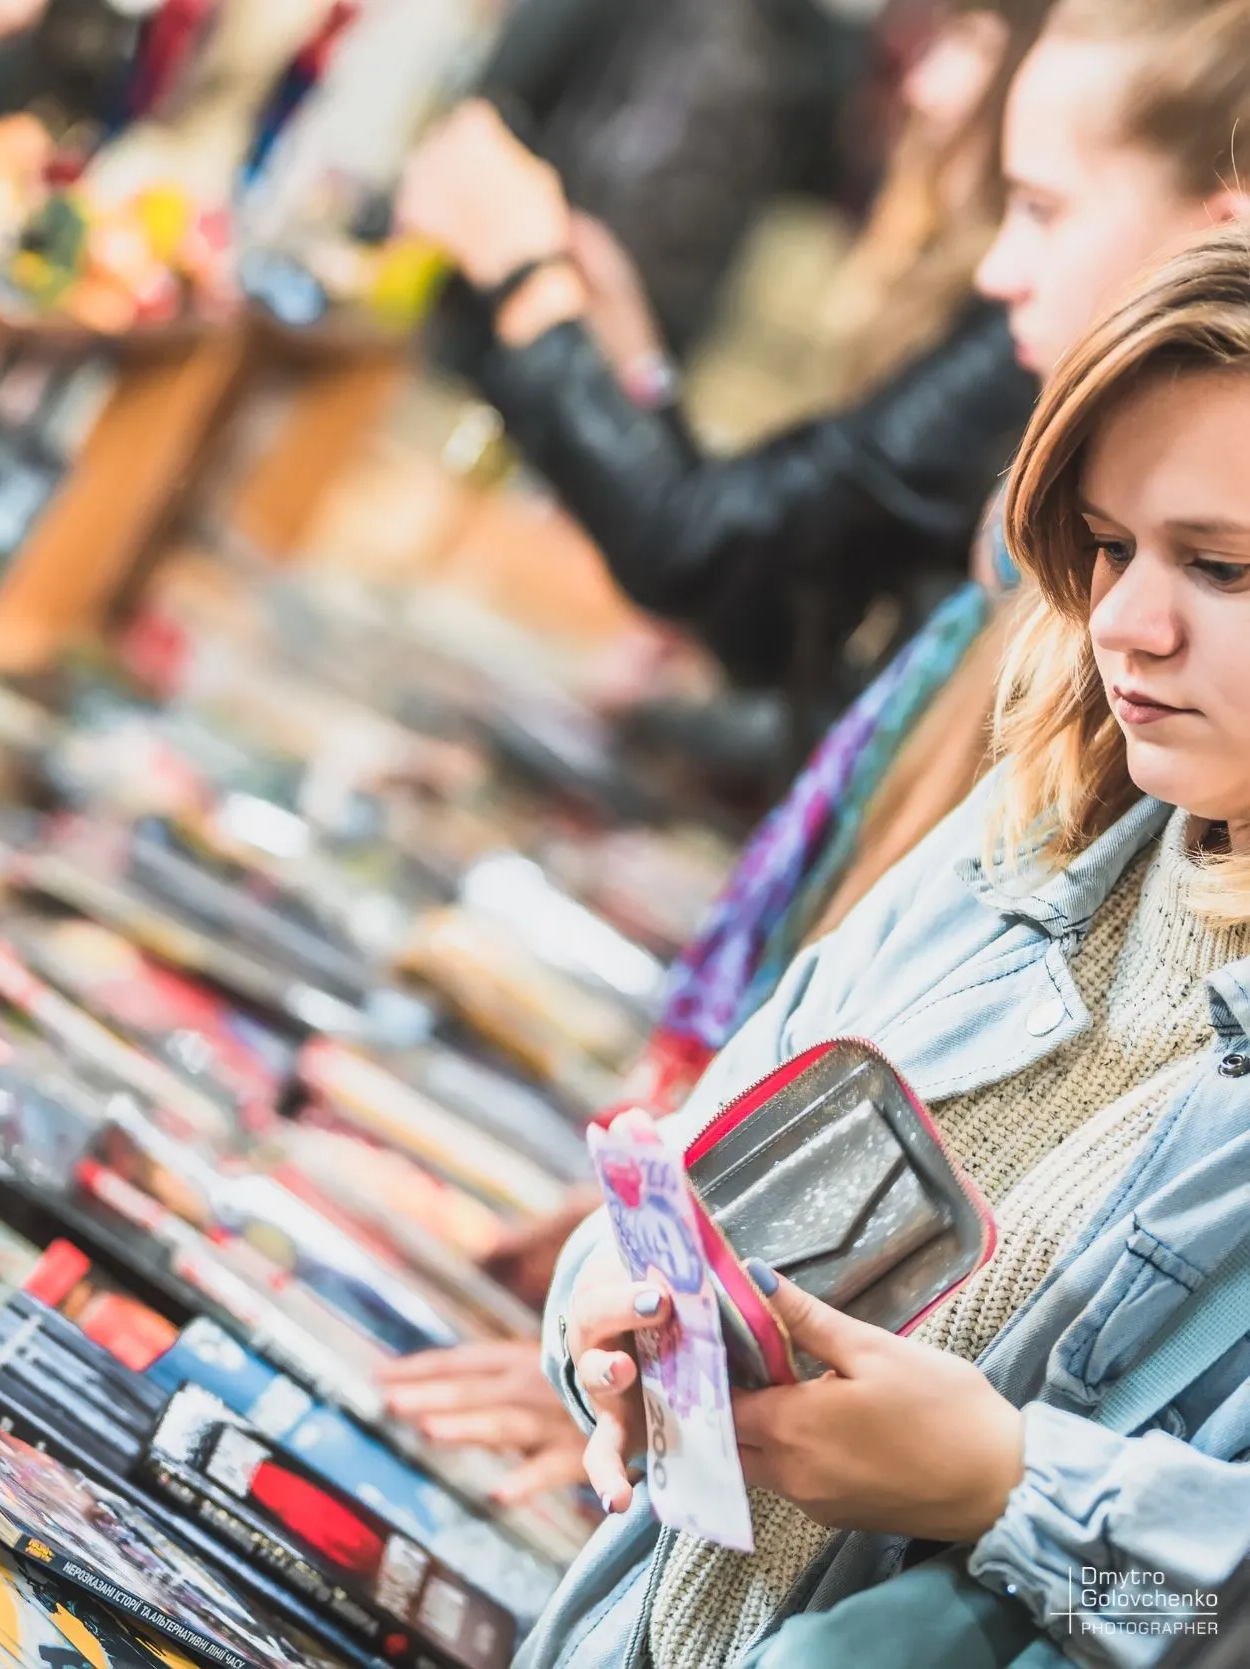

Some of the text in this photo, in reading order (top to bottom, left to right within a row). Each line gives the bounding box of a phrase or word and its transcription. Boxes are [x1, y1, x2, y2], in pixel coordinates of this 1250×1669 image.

[648, 1399, 668, 1491] 200
[63, 1561, 246, 1669] НЕРОЗКАЗАНІ ІСТОРІЇ ТА АЛЬТЕРНАТИВНІ ЛІНІЇ ЧАСУ
